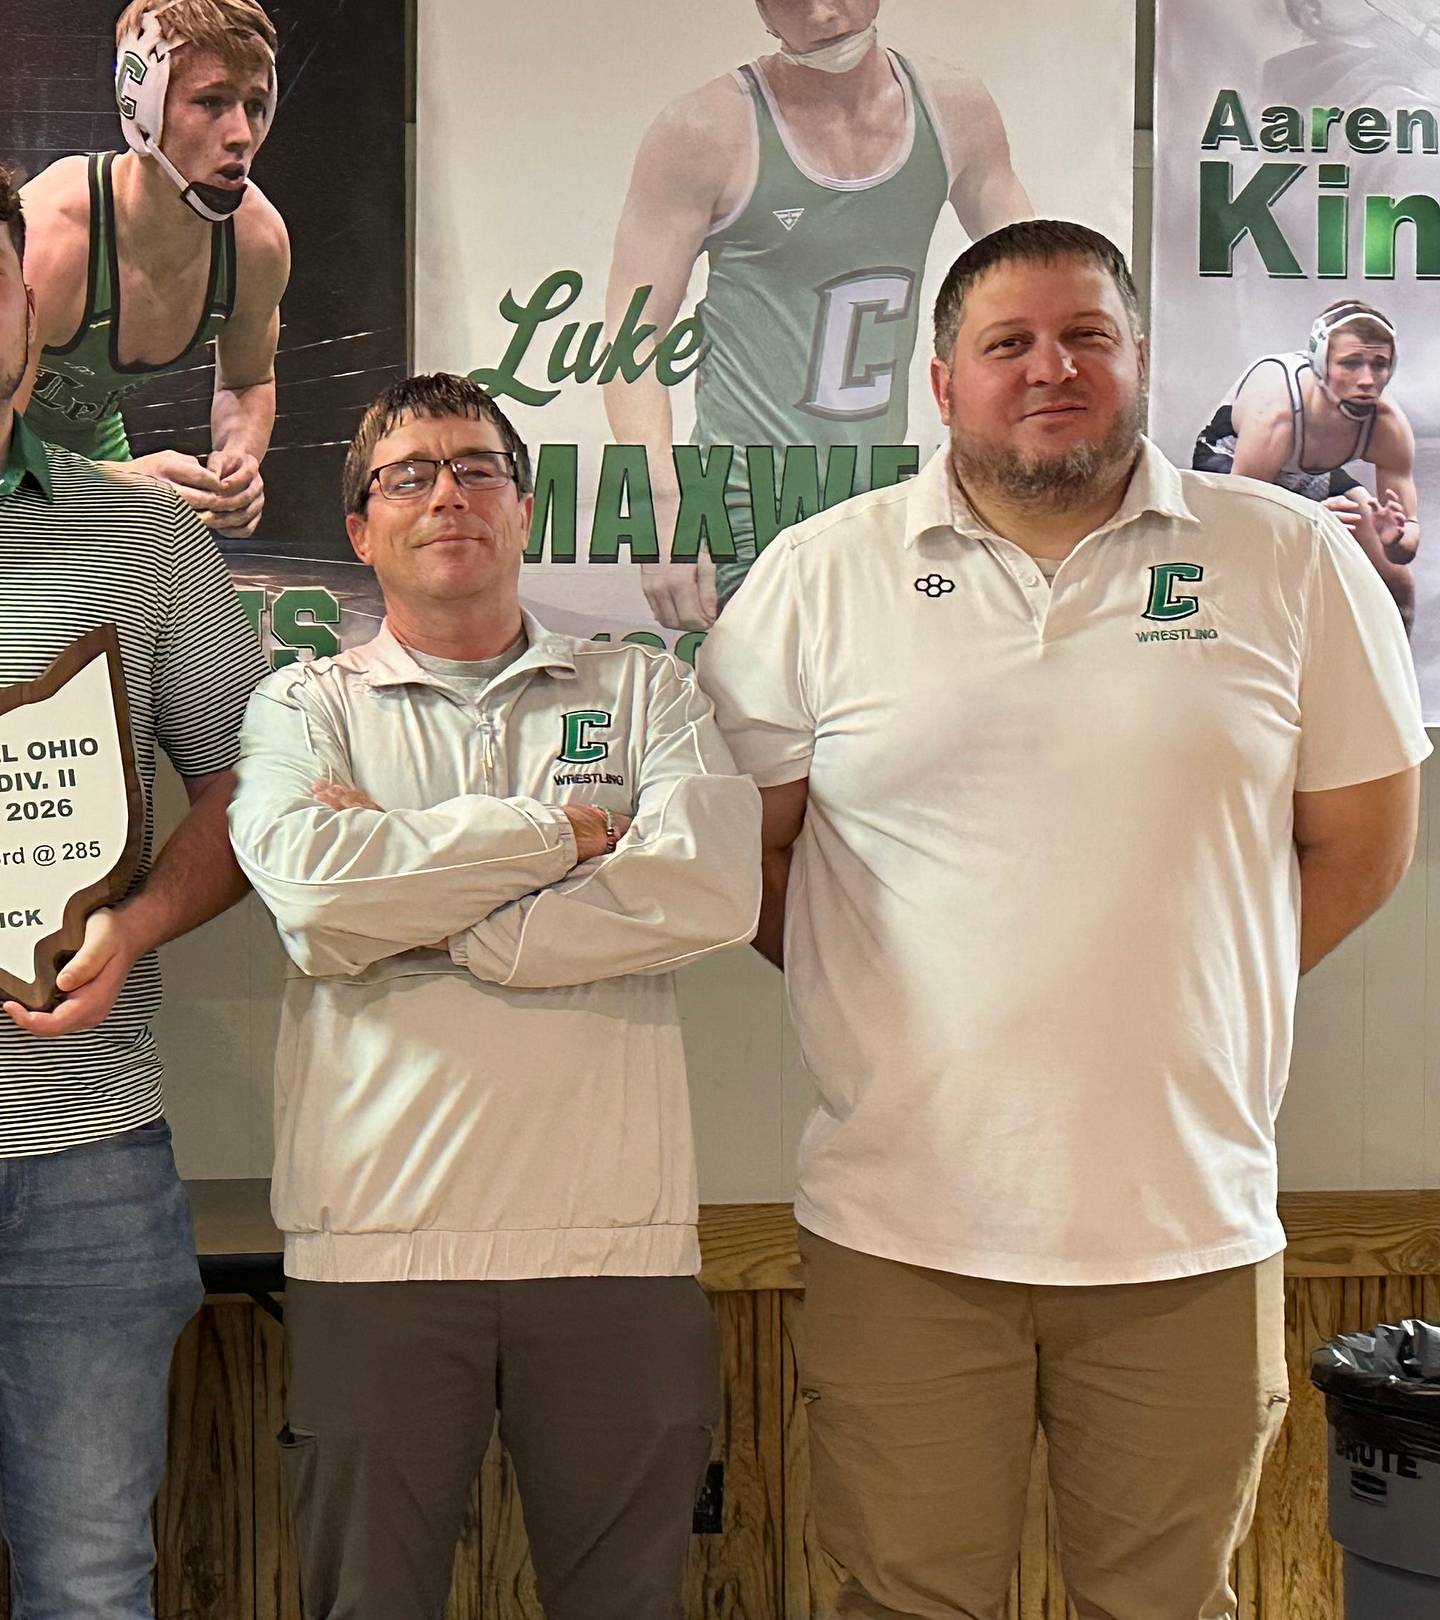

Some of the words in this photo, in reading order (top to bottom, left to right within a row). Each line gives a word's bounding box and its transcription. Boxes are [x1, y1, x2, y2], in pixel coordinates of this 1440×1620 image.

[1201, 88, 1439, 155] Aaren
[467, 269, 712, 407] Luke
[1135, 628, 1218, 642] WRESTLING
[27, 737, 99, 761] OHIO
[58, 768, 77, 788] II
[553, 773, 624, 786] WRESTLING
[5, 798, 74, 822] 2026
[32, 844, 57, 867] @
[62, 840, 102, 861] 285
